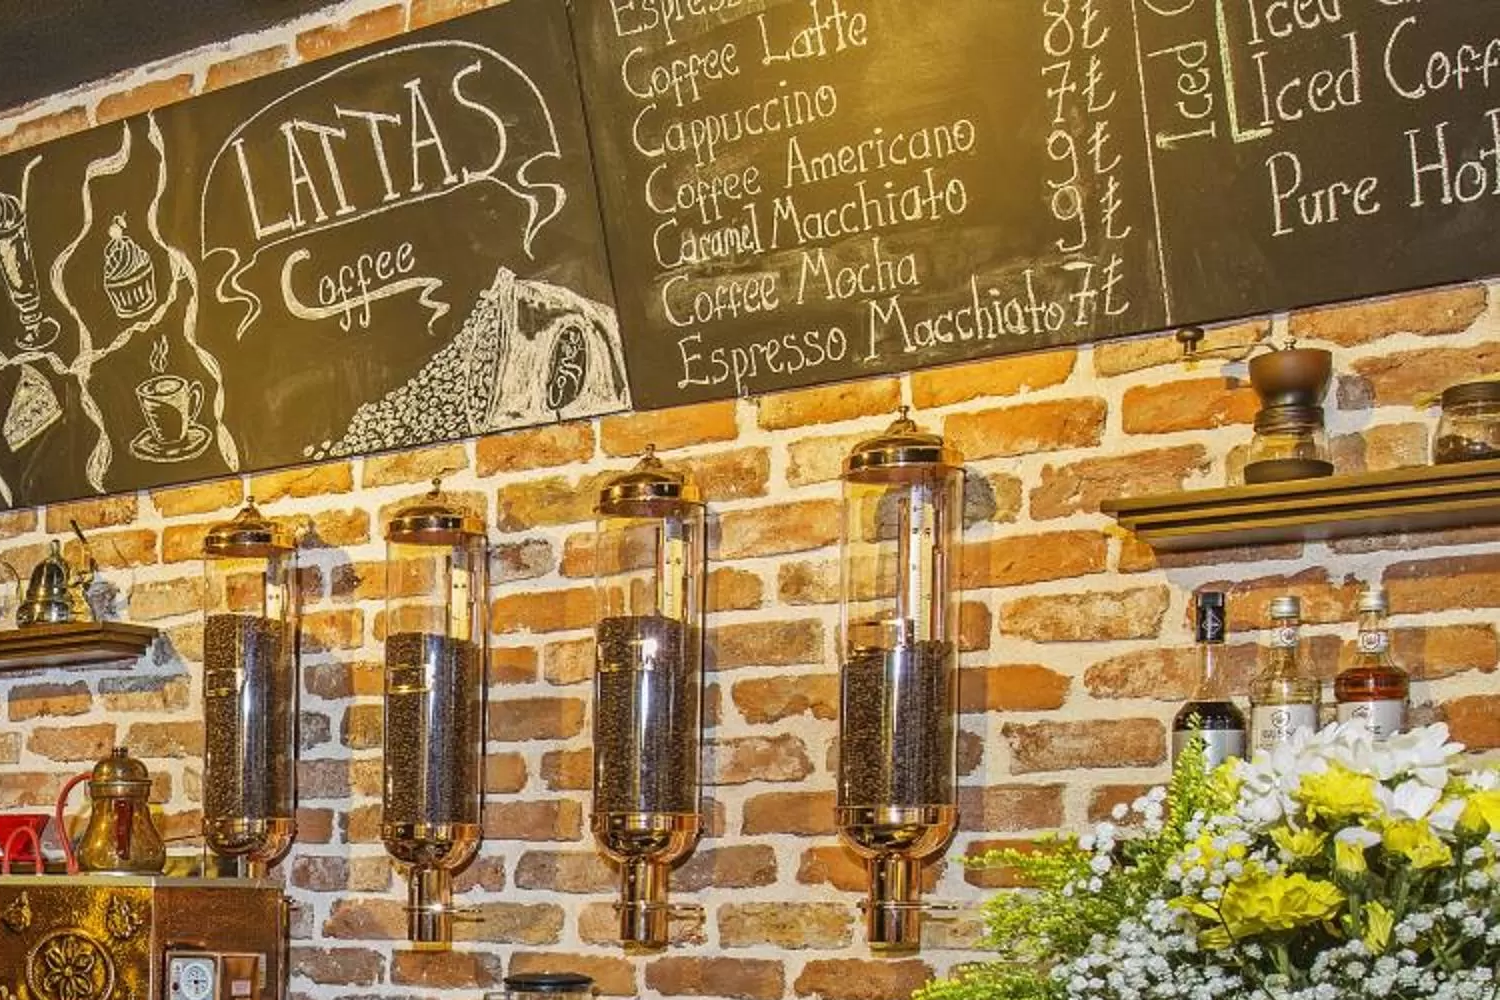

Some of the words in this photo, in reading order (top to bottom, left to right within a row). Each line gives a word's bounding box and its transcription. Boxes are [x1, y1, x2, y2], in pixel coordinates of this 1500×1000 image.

[621, 43, 740, 107] Coffee
[756, 0, 868, 66] Latte
[1146, 40, 1217, 150] Iced
[1252, 32, 1362, 126] Iced
[231, 59, 508, 240] LATTAS
[632, 80, 838, 167] Cappuccino
[645, 162, 762, 225] Coffee
[785, 119, 977, 189] Americano
[653, 202, 765, 268] Caramel
[770, 168, 968, 249] Macchiato
[1265, 151, 1381, 238] Pure
[281, 241, 444, 332] Coffee
[662, 272, 780, 327] Coffee
[796, 236, 921, 305] Mocha
[676, 326, 847, 394] Espresso
[863, 269, 1065, 362] Macchiato
